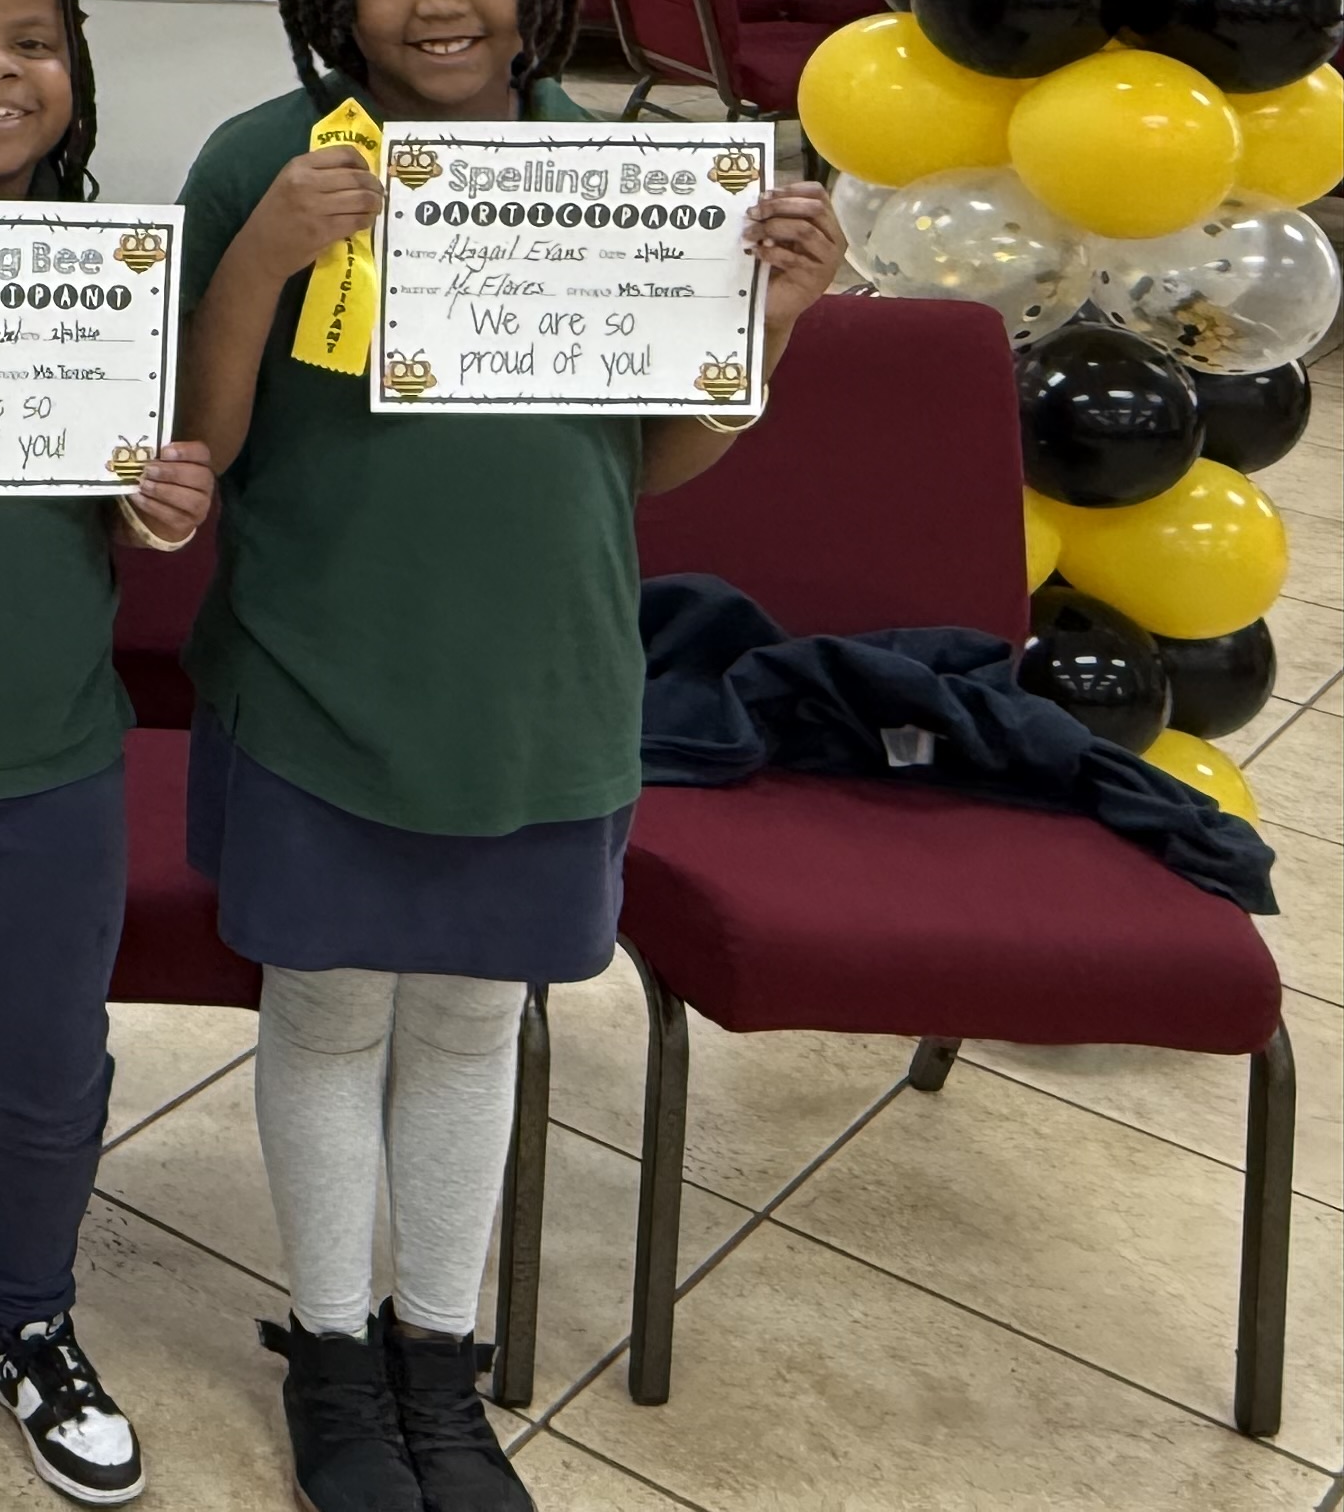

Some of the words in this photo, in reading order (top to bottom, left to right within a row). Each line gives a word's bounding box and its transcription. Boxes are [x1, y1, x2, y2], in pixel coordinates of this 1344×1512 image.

[316, 130, 377, 150] SPELLING
[447, 159, 610, 201] Spelling
[618, 162, 698, 197] Bee
[420, 203, 722, 229] PARTICIPANT
[31, 240, 104, 275] Bee
[326, 242, 356, 355] RTICIPANT
[470, 303, 521, 334] We
[538, 308, 587, 334] are
[605, 306, 637, 334] so
[460, 347, 535, 387] proud
[553, 342, 584, 376] of
[601, 345, 654, 388] you!
[23, 396, 53, 419] so
[18, 429, 67, 470] you!
